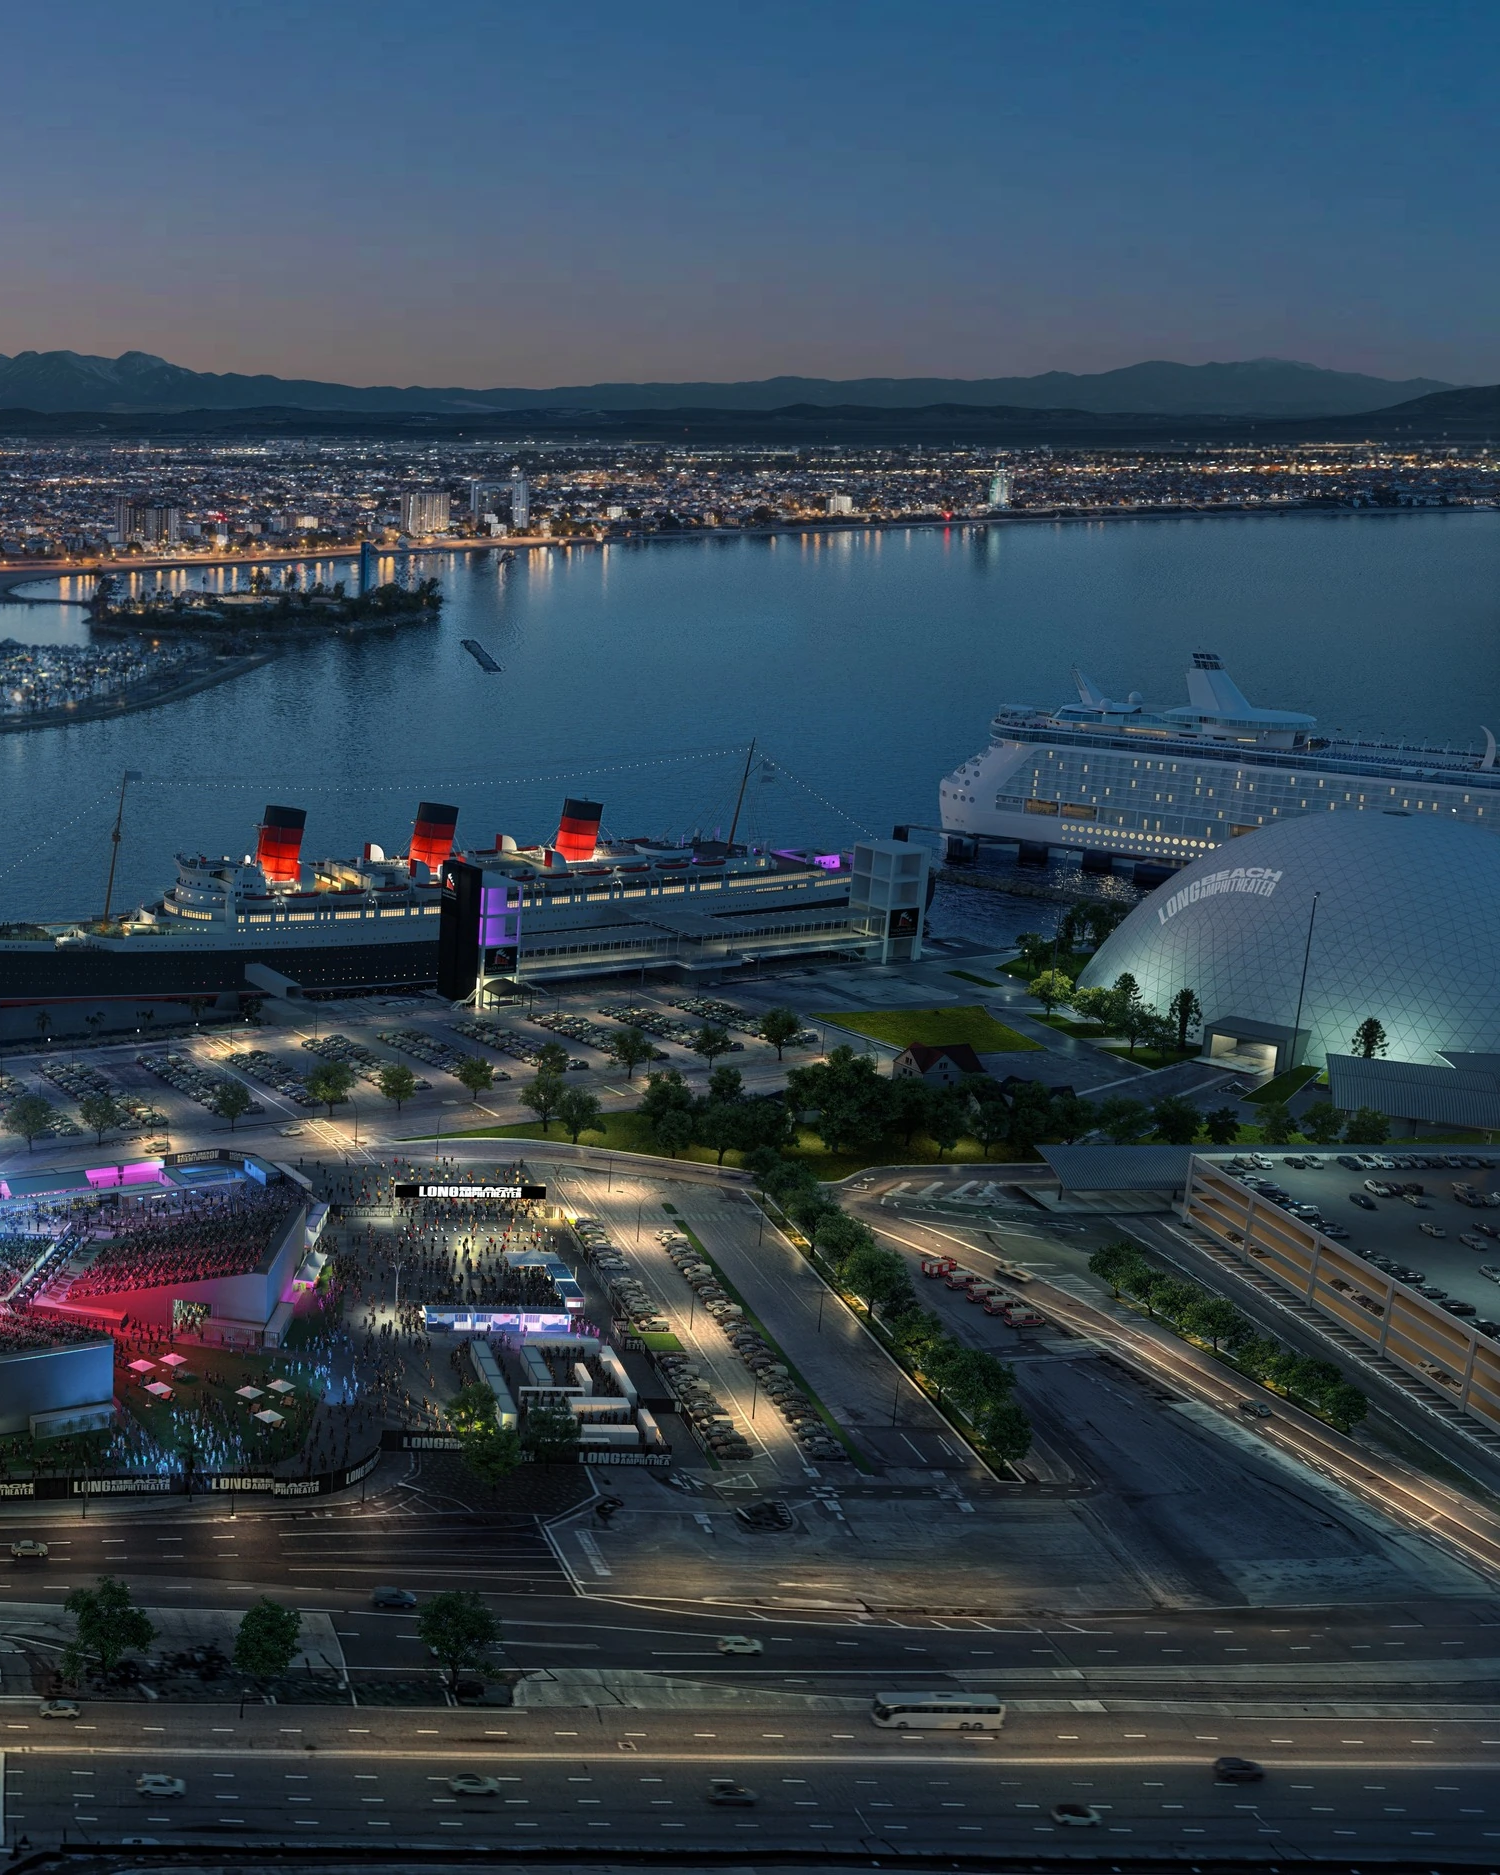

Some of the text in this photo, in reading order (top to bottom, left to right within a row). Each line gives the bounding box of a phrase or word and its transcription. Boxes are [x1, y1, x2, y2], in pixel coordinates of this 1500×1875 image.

[1200, 878, 1278, 898] AMPHITHEATER
[1157, 867, 1283, 925] LONG BEACH
[459, 1190, 522, 1198] AMPHITHEATER
[403, 1437, 443, 1449] LONG
[579, 1452, 620, 1464] LONG
[73, 1481, 110, 1493] LONG
[111, 1483, 170, 1492] AMPHITHEATER
[212, 1478, 251, 1490] LONG
